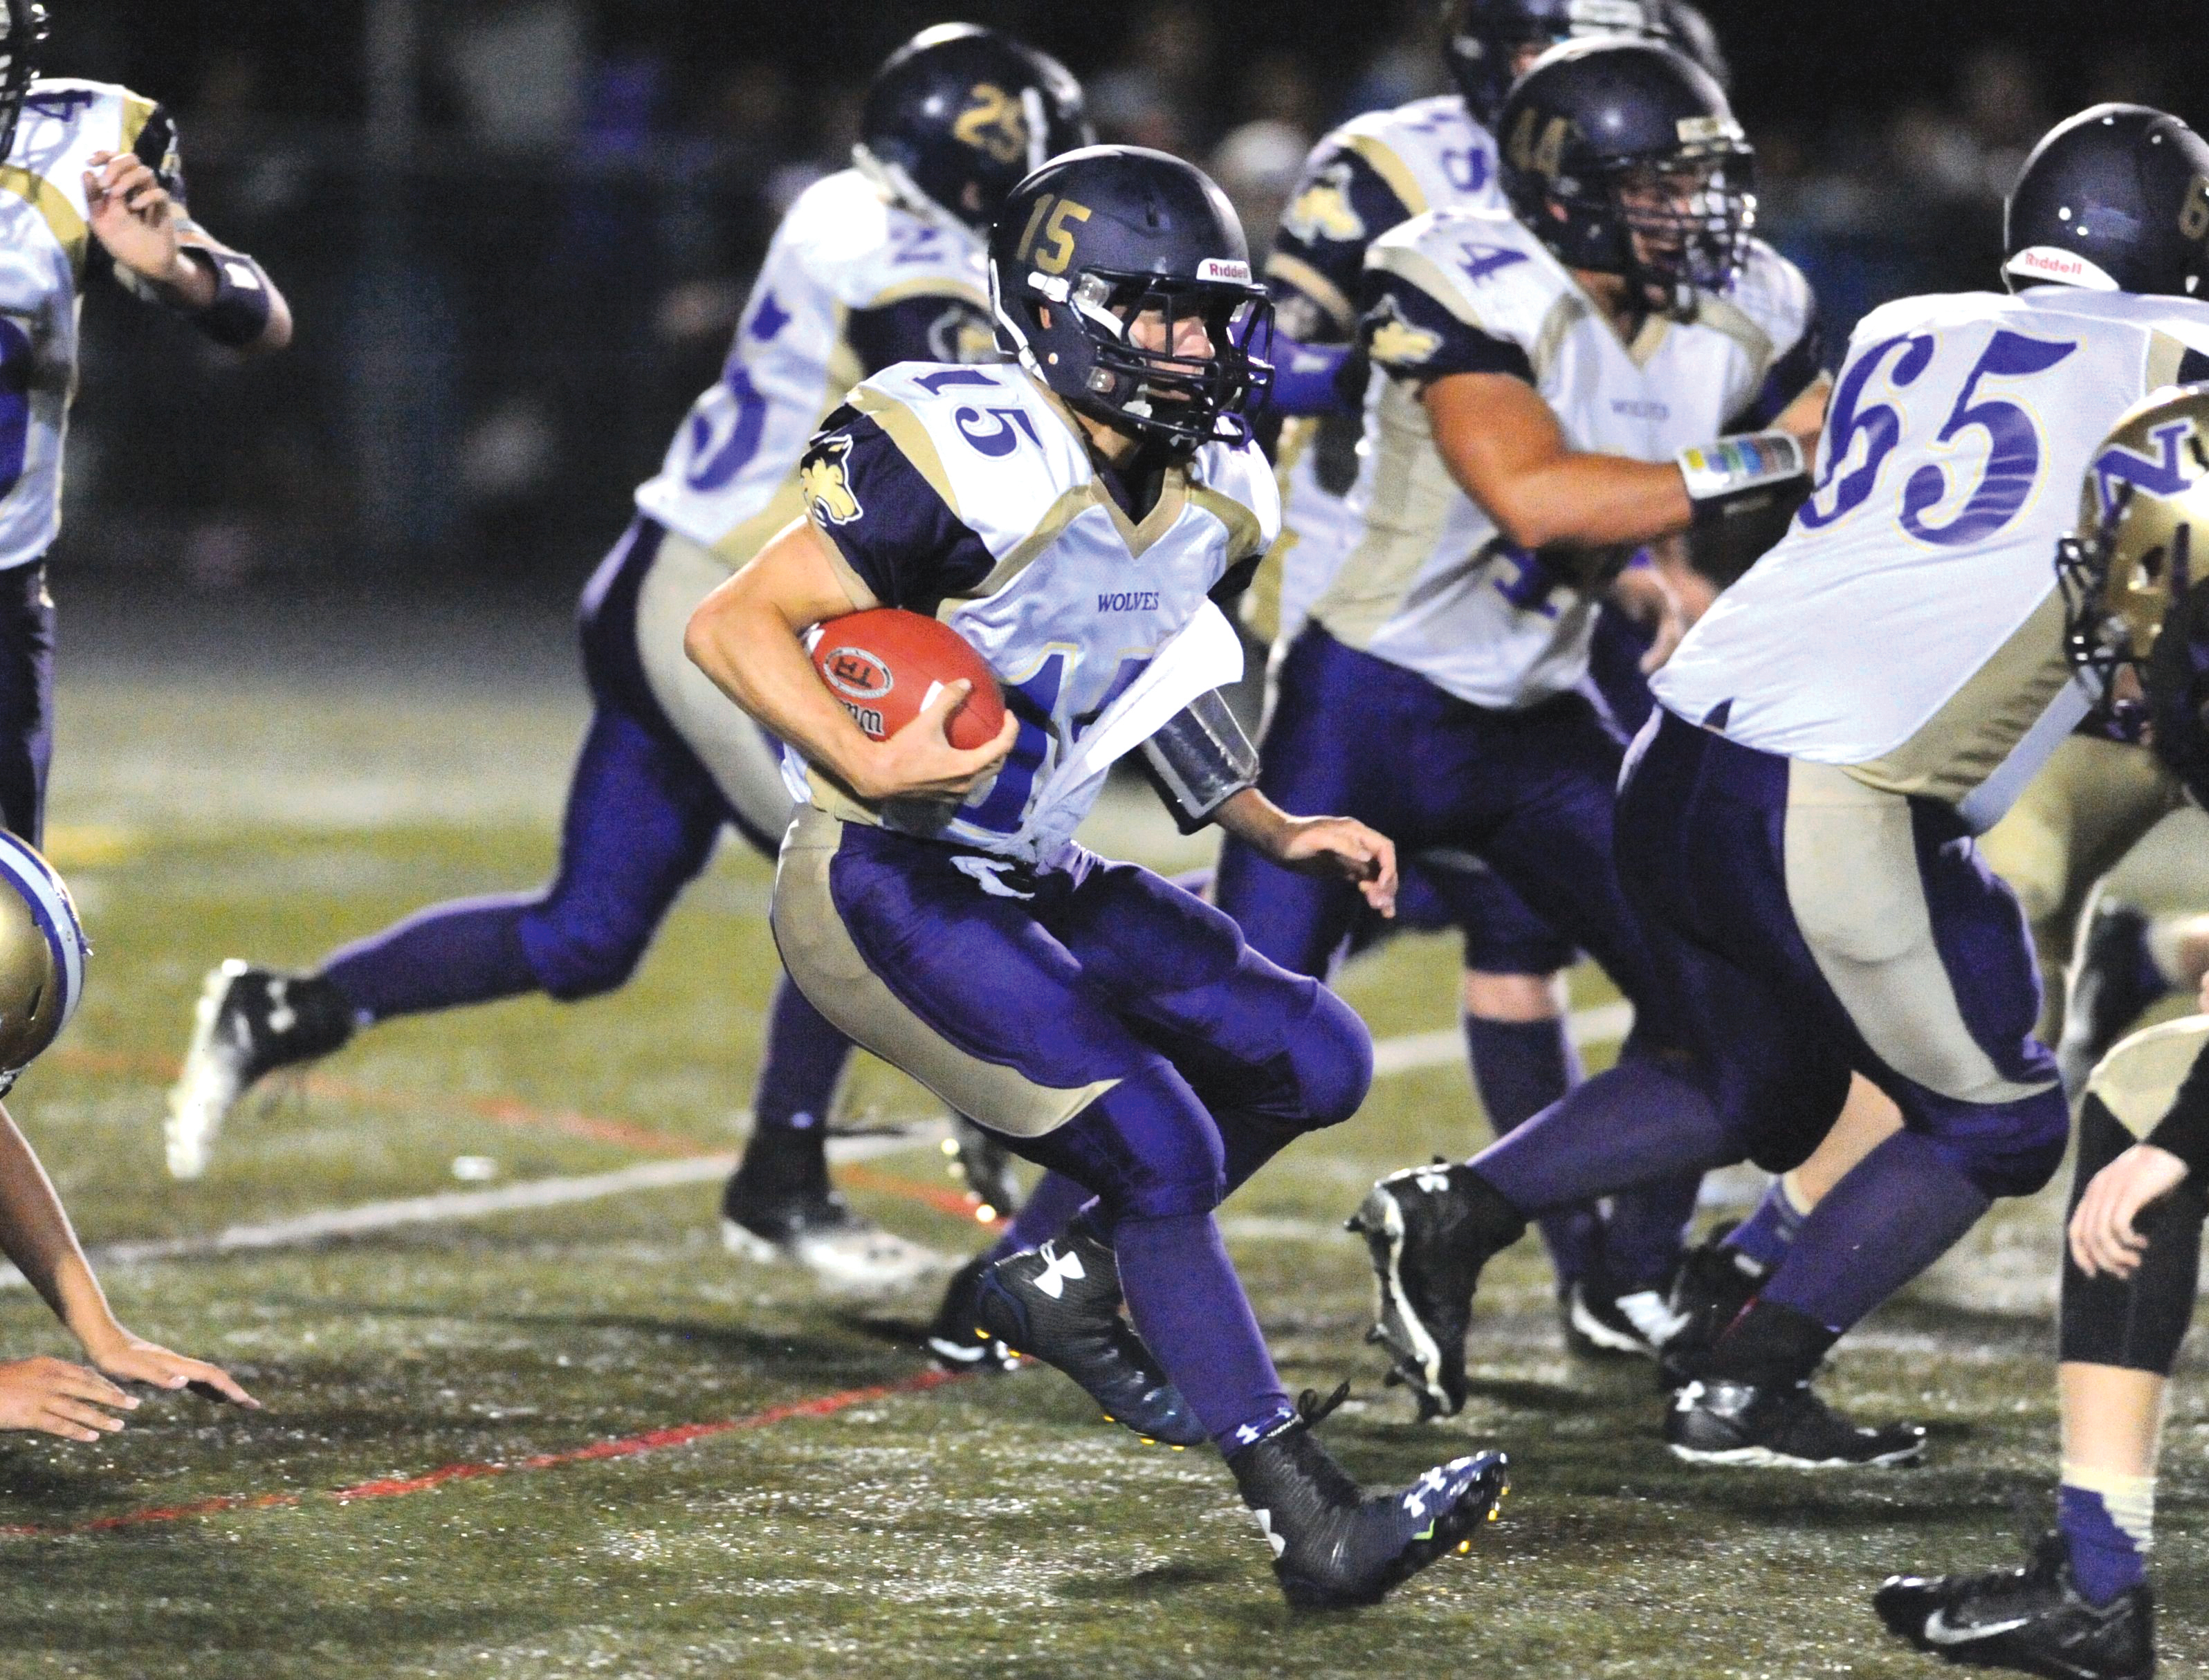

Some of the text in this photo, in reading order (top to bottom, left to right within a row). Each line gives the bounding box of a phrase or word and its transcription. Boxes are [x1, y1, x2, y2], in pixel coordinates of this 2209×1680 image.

[1015, 192, 1092, 275] 15
[1209, 262, 1248, 279] Riddell
[2026, 251, 2082, 275] Riddell
[910, 368, 1045, 460] 15
[1798, 326, 2080, 548] 65
[1098, 591, 1160, 612] WOLVES
